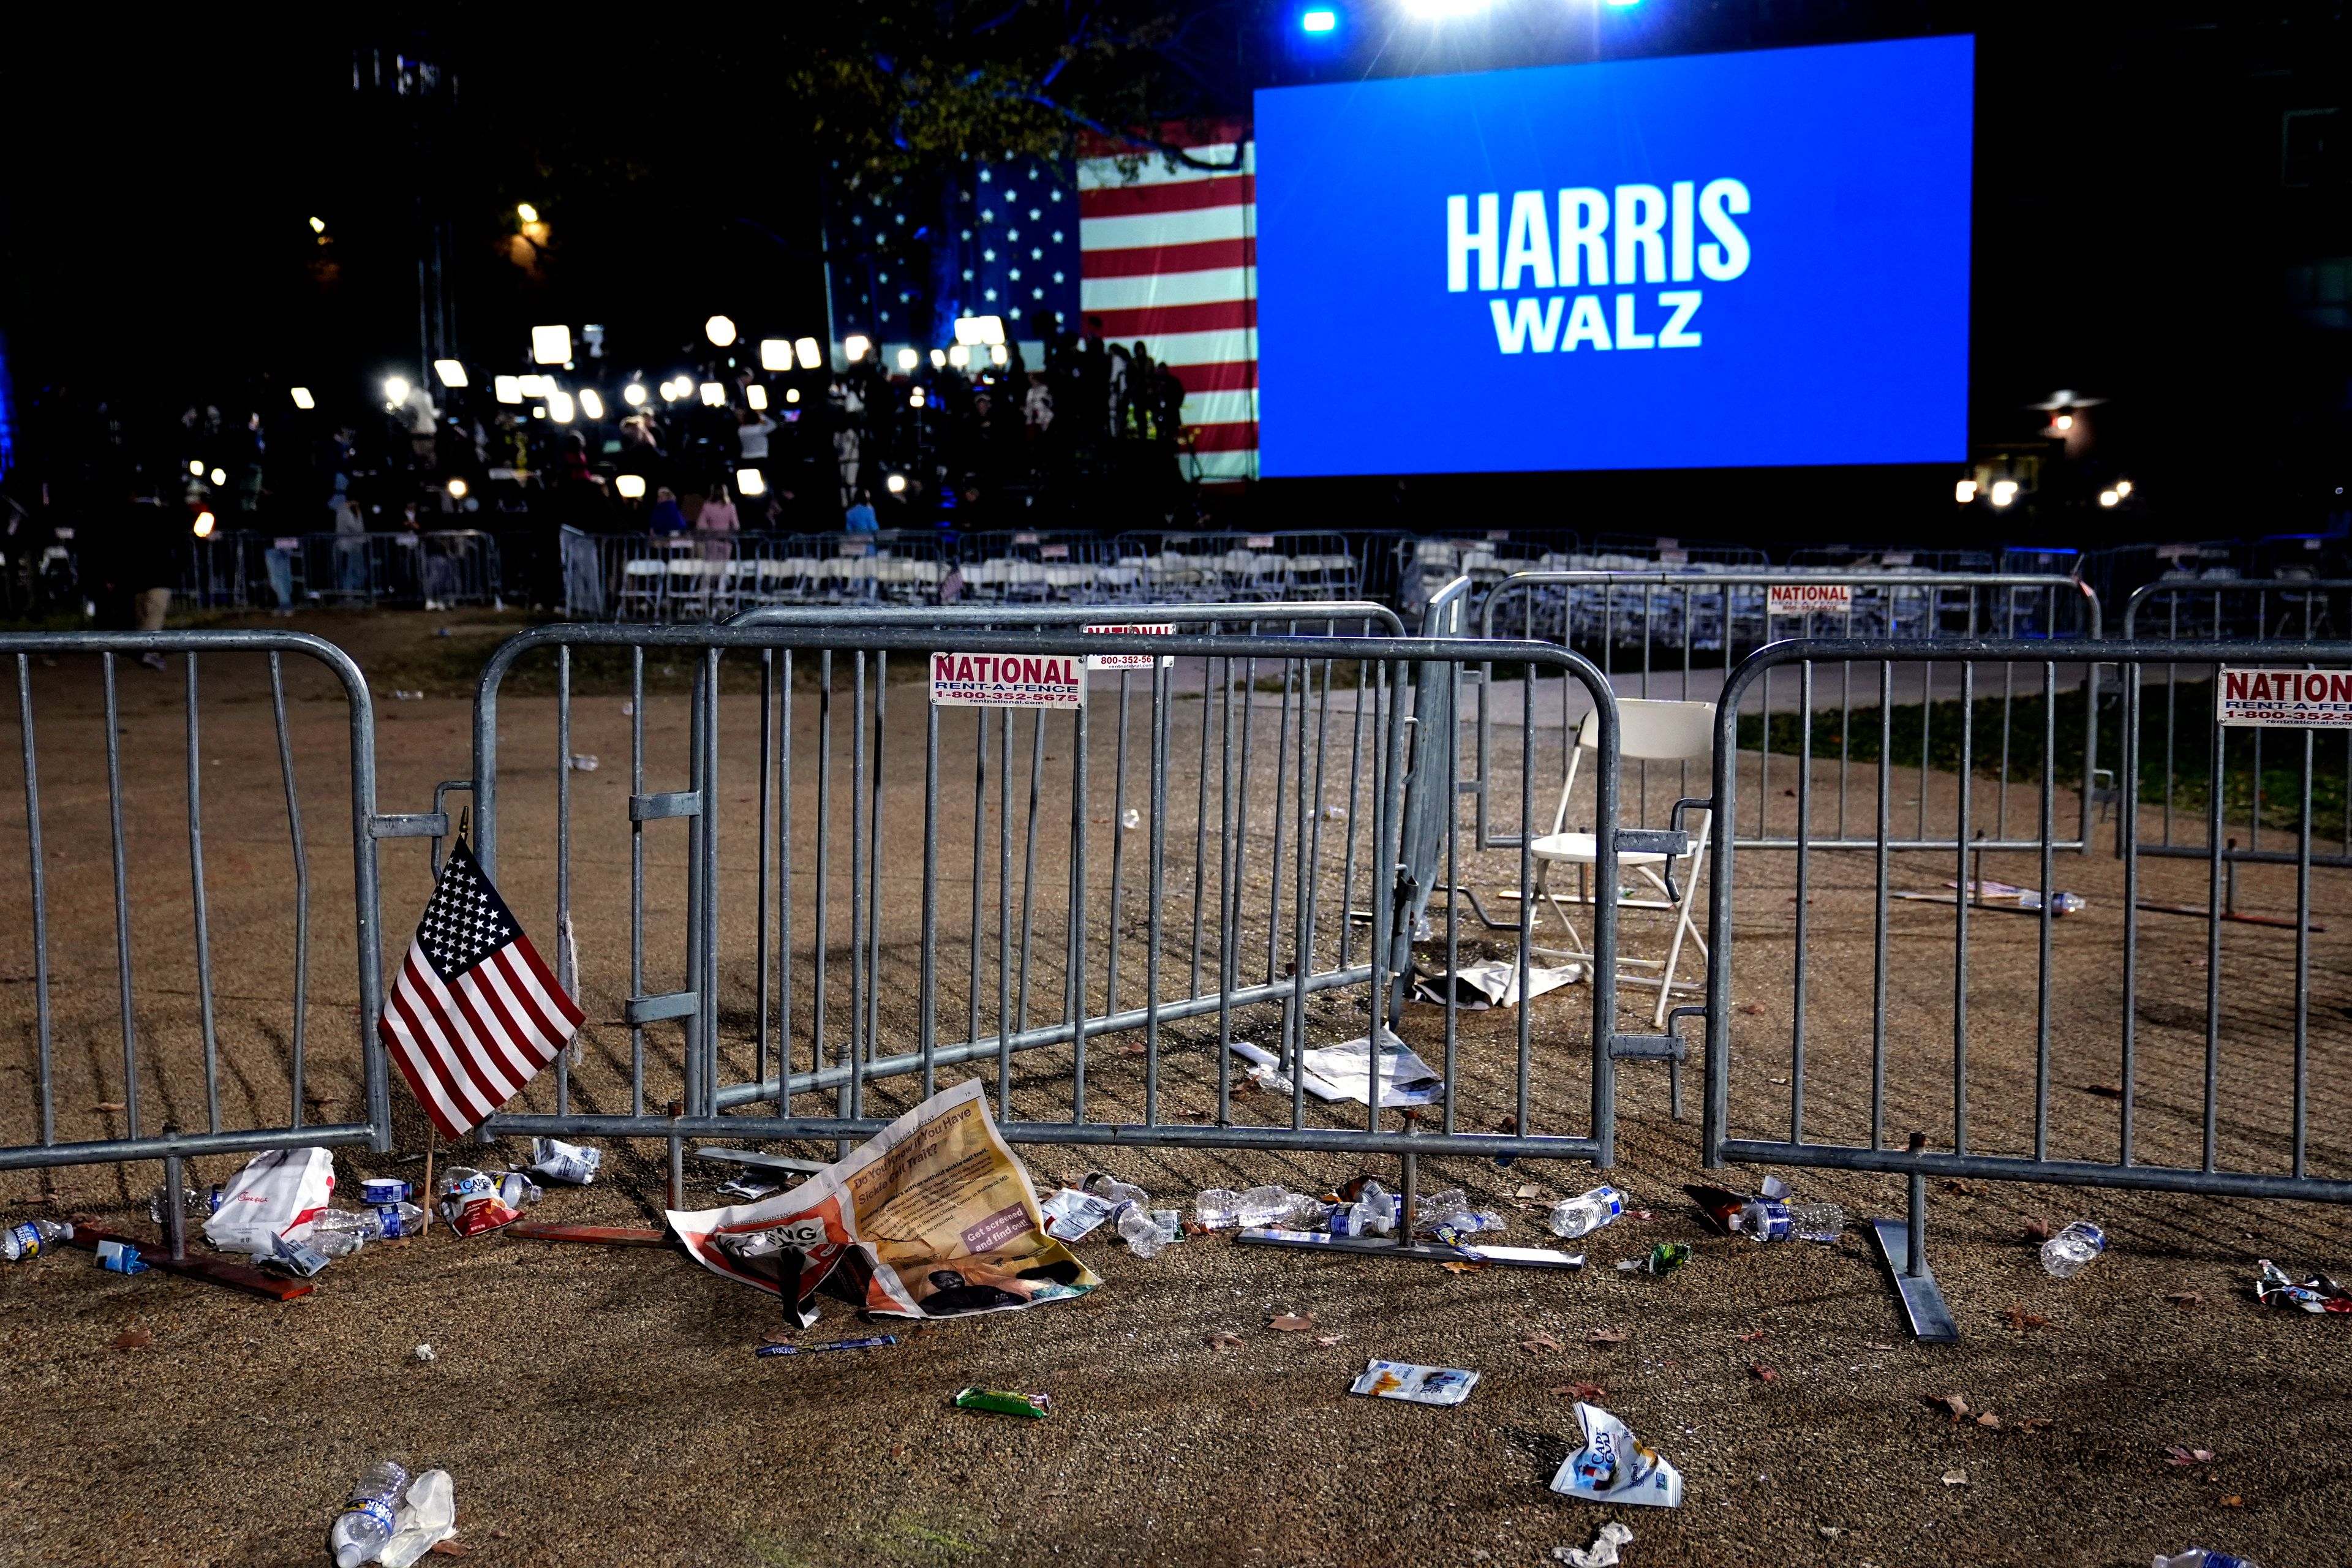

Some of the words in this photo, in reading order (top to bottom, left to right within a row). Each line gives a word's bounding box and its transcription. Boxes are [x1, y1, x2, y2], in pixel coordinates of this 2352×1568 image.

[1447, 177, 1752, 293] HARRIS
[1489, 290, 1703, 355] WALZ
[1771, 586, 1849, 601] NATIONAL
[935, 655, 1079, 685] NATIONAL
[935, 682, 1079, 693] RENT-A-FENCE
[935, 690, 1078, 702] 1-800-352-5675
[2225, 701, 2352, 711] RENT-A-FE
[854, 1175, 867, 1189] Do
[867, 1163, 888, 1179] You
[887, 1143, 913, 1167] Know
[914, 1136, 921, 1148] if
[921, 1124, 943, 1140] You
[942, 1109, 971, 1129] Have
[884, 1129, 912, 1153] SPONSORED
[858, 1181, 888, 1205] Sickle
[889, 1163, 906, 1183] Cell
[907, 1142, 938, 1168] Trait?
[886, 1200, 907, 1213] National
[906, 1188, 929, 1202] Institutes
[933, 1177, 949, 1188] Health
[970, 1156, 992, 1169] studying
[904, 1183, 917, 1194] with
[924, 1170, 945, 1183] without
[946, 1161, 963, 1173] sickle
[962, 1155, 974, 1164] cell
[974, 1147, 989, 1158] trait.
[891, 1209, 902, 1218] trait
[902, 1199, 921, 1213] changes
[963, 1167, 981, 1178] vessels
[981, 1161, 994, 1170] work.
[930, 1213, 940, 1222] NIH
[939, 1204, 957, 1216] Clinical
[956, 1196, 973, 1207] Center
[977, 1179, 1001, 1194] Bethesda,
[1000, 1172, 1009, 1183] MD.
[723, 1218, 761, 1228] SPONSORED
[763, 1212, 793, 1221] CONTENT
[902, 1210, 916, 1219] sickle
[925, 1200, 936, 1208] trait
[918, 1205, 939, 1219] provided
[933, 1215, 956, 1229] provided.
[967, 1228, 986, 1242] Get
[986, 1207, 1023, 1233] screened
[14, 1227, 28, 1245] PARK
[22, 1225, 34, 1243] DEER
[975, 1237, 993, 1252] and
[993, 1226, 1012, 1242] find
[1012, 1219, 1028, 1231] out!
[1591, 1427, 1605, 1465] CAPE
